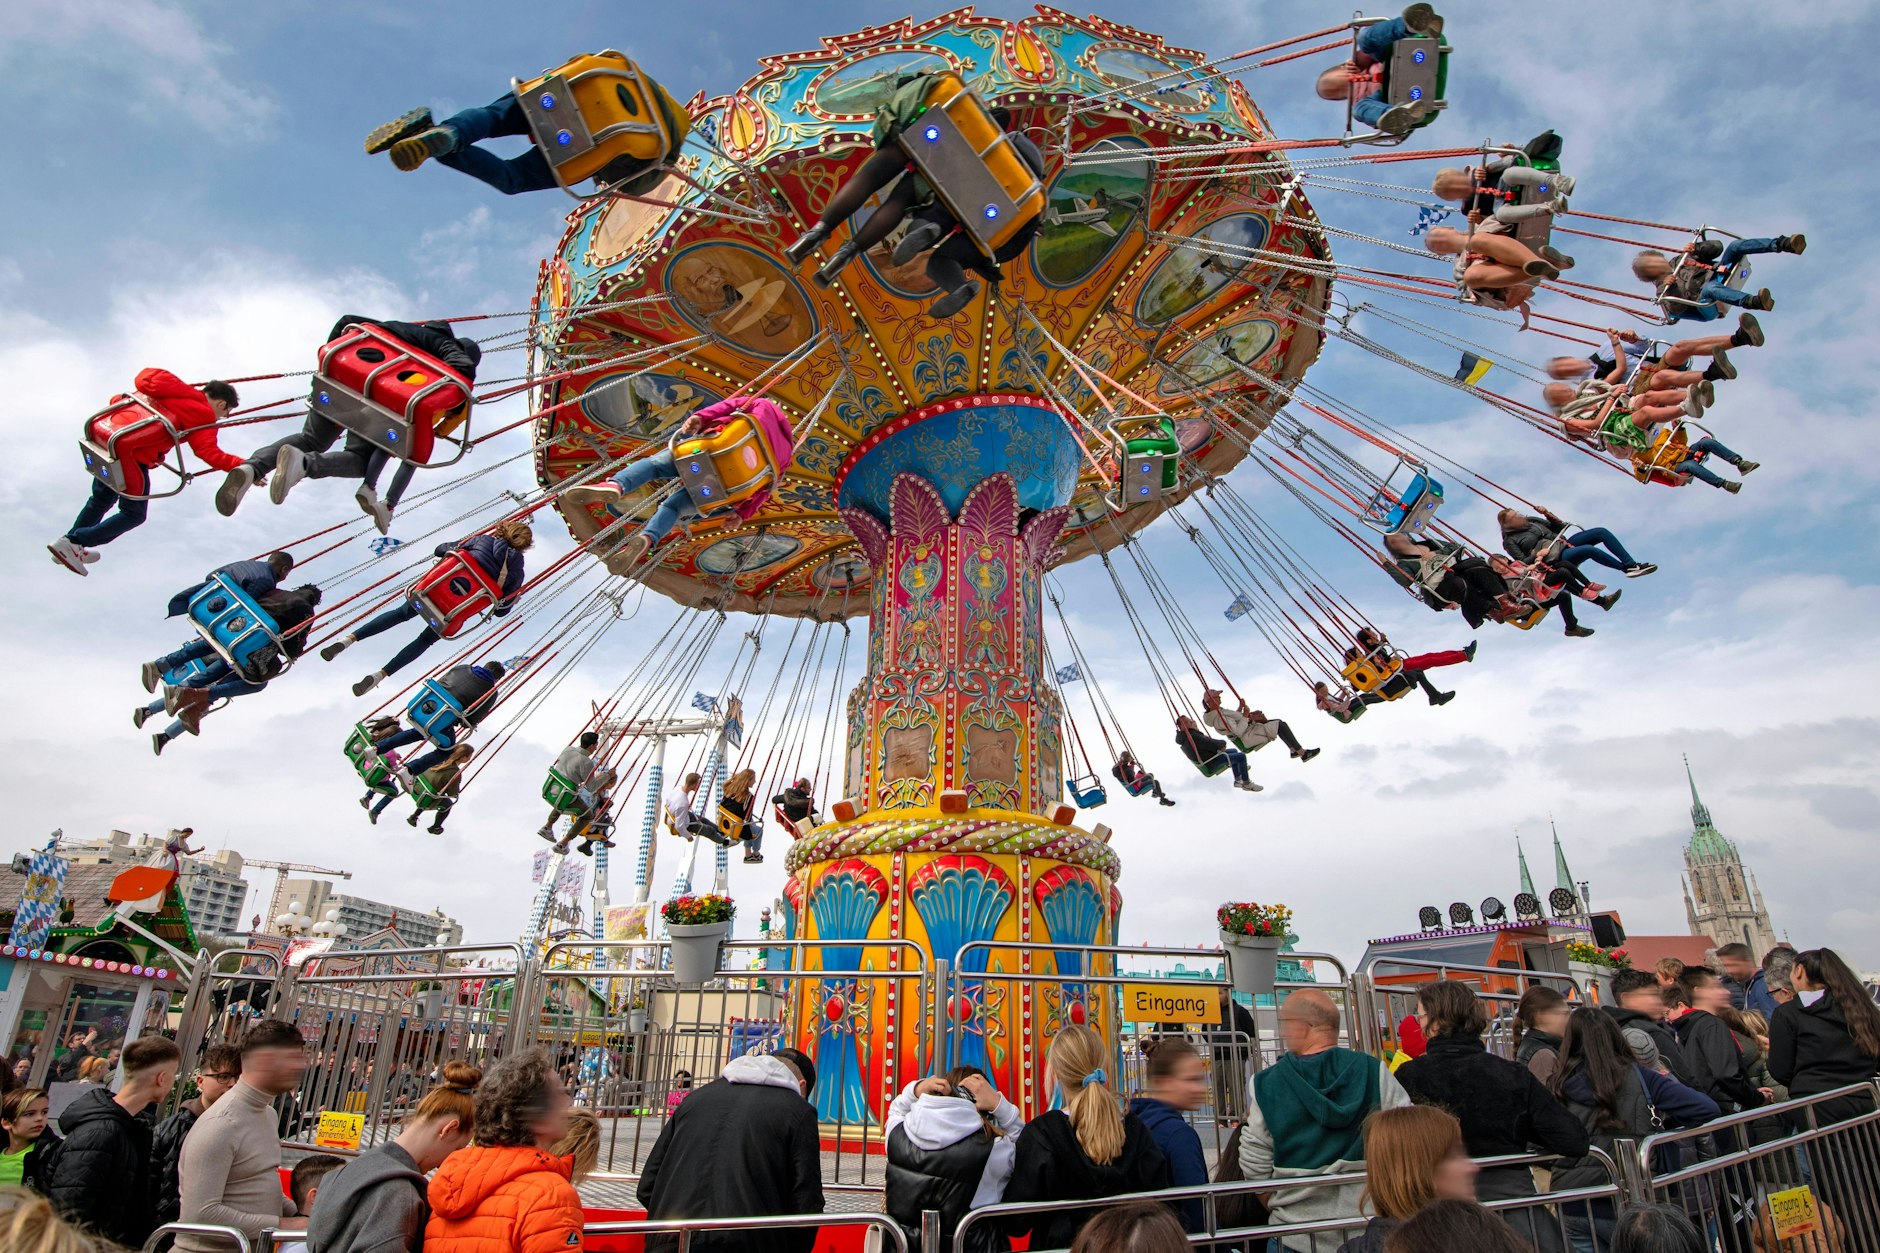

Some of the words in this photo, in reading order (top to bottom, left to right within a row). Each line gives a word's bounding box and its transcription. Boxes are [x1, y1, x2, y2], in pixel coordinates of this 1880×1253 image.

[1136, 991, 1206, 1017] Eingang
[321, 1114, 347, 1132] Eingang
[1771, 1197, 1801, 1216] Eingang
